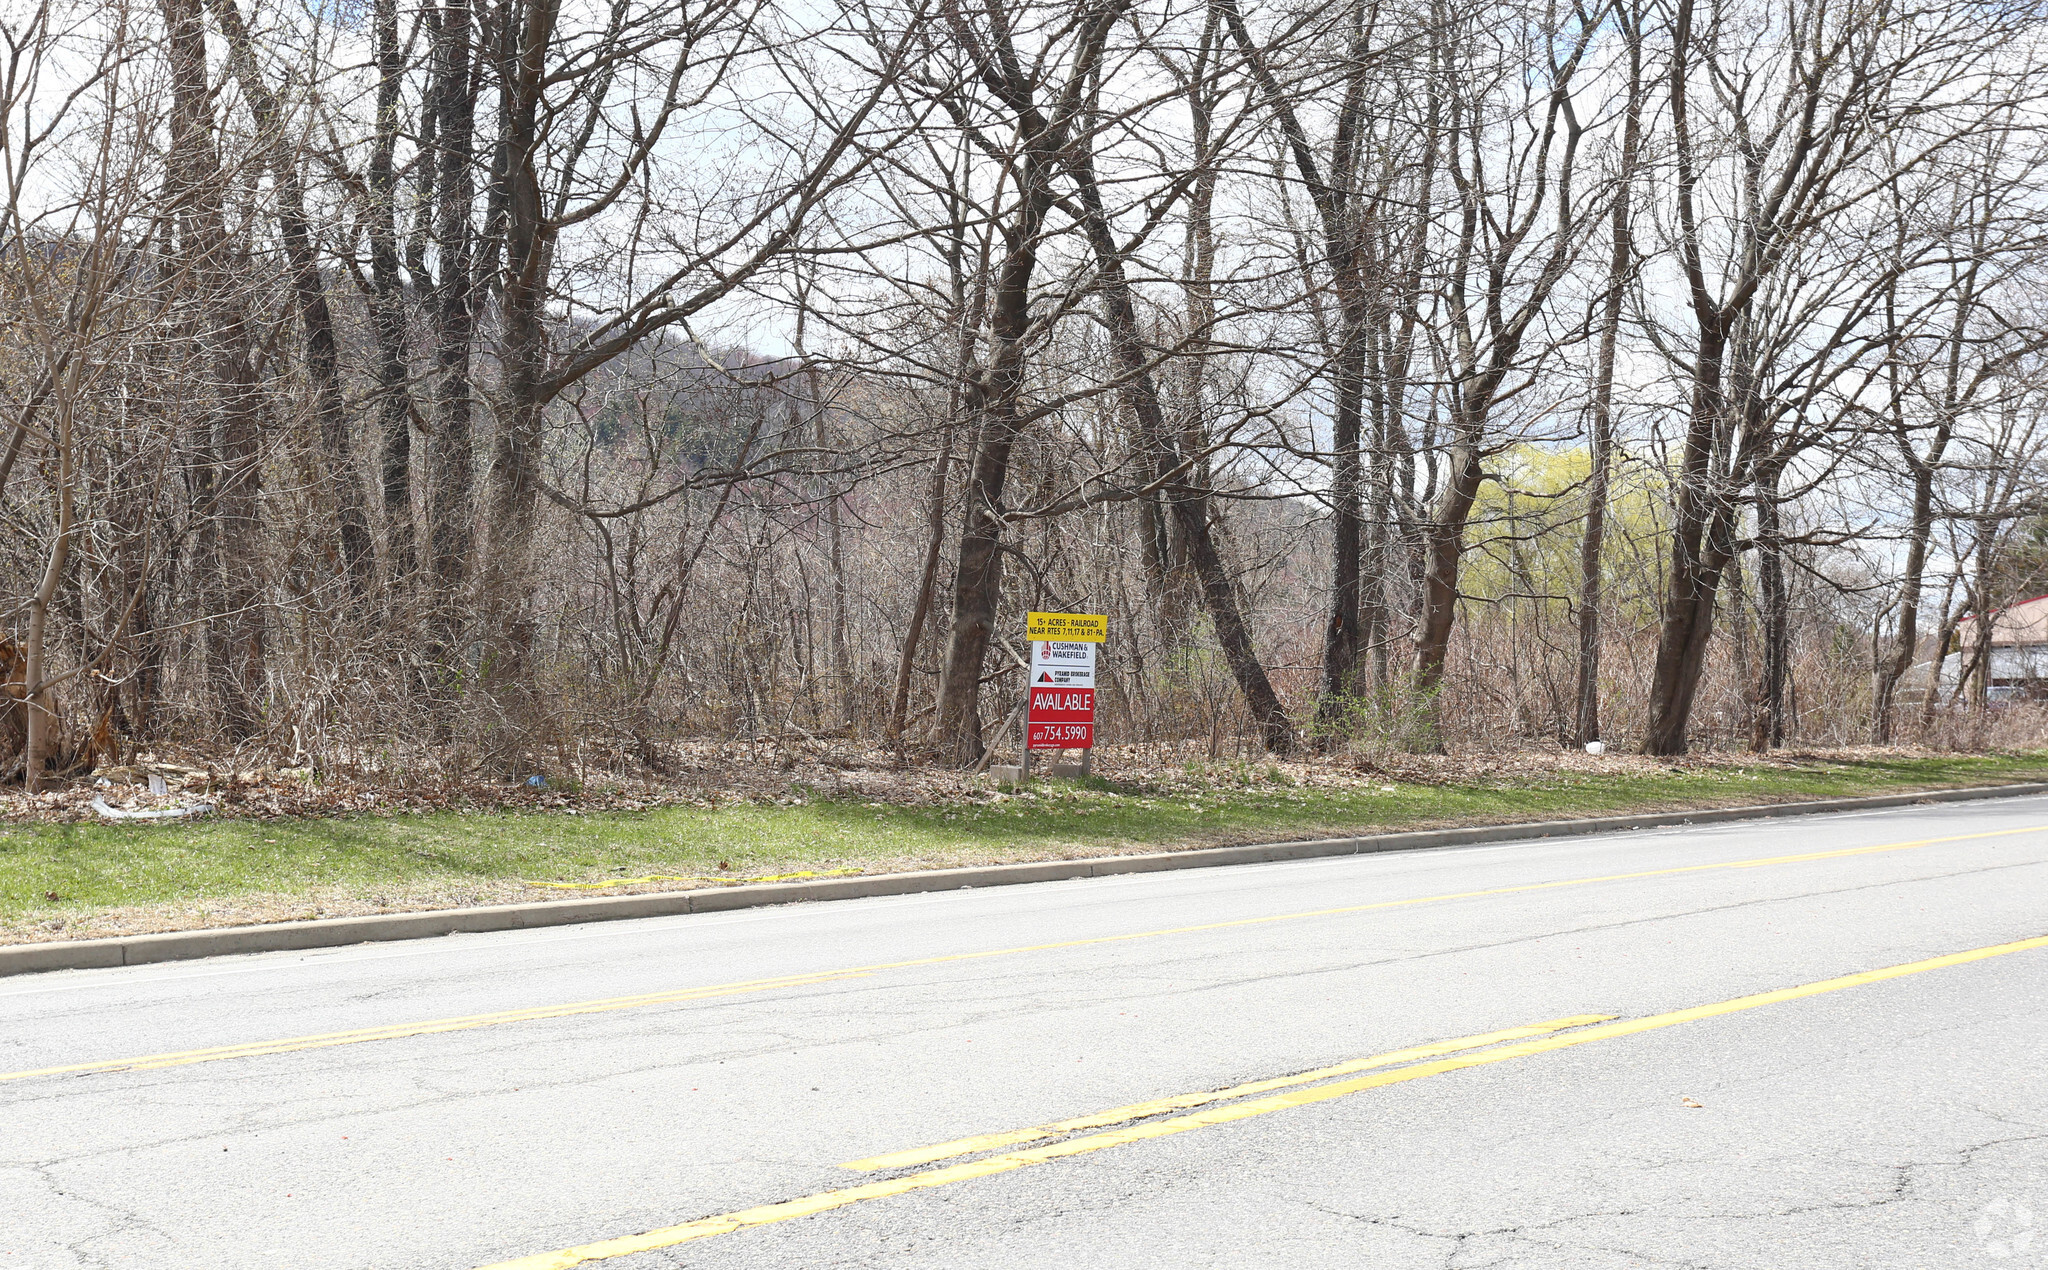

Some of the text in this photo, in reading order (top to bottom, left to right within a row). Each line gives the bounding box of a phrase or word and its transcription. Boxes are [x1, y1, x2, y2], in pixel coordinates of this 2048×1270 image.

[1048, 618, 1067, 627] ACRES
[1071, 619, 1099, 628] RAILROAD
[1029, 627, 1046, 635] NEAR
[1047, 627, 1061, 635] RTES
[1052, 651, 1086, 659] WAKEFIELD
[1032, 693, 1091, 710] AVAILABLE
[1033, 726, 1087, 740] 607 754.5990
